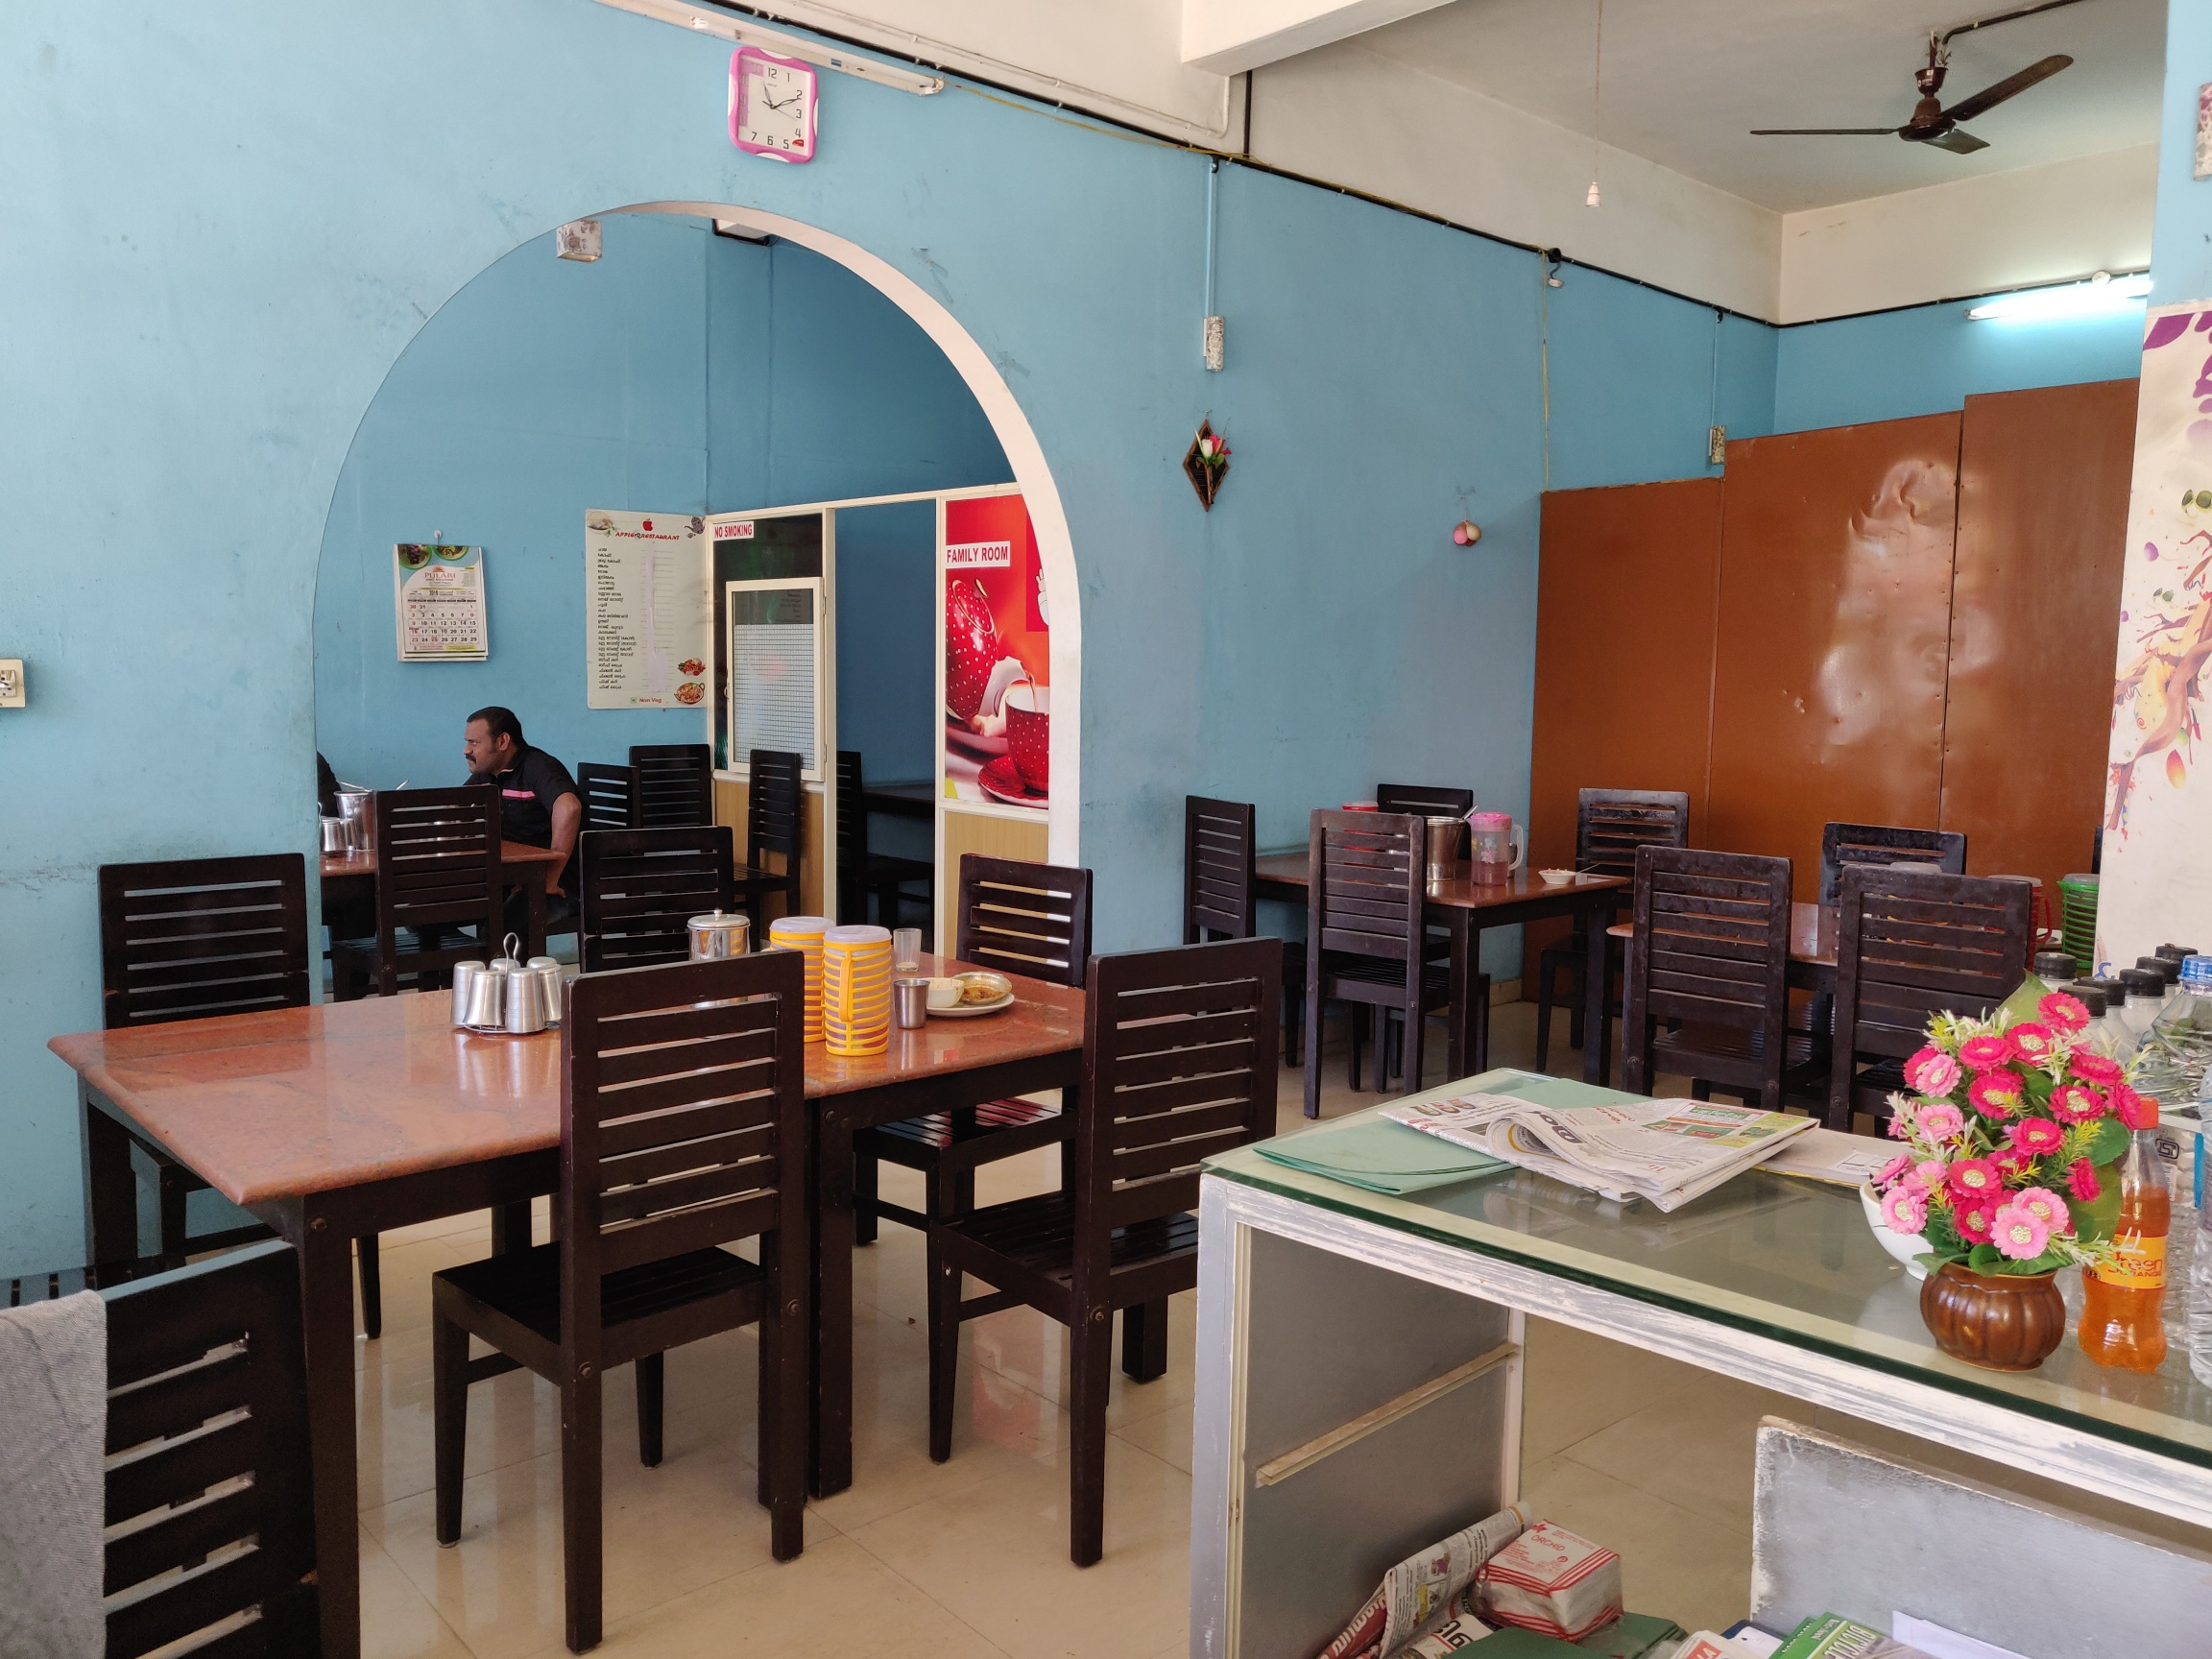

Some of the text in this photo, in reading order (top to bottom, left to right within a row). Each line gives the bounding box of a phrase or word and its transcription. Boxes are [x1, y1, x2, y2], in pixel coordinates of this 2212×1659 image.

[768, 67, 777, 79] 12
[796, 89, 803, 100] 2
[796, 108, 802, 119] 3
[752, 132, 757, 141] 7
[795, 128, 801, 138] 4
[767, 135, 774, 146] 6
[783, 138, 789, 150] 5
[714, 524, 753, 538] NO SMOKING
[947, 545, 1008, 564] FAMILY ROOM
[1530, 1534, 1566, 1551] ORCHID
